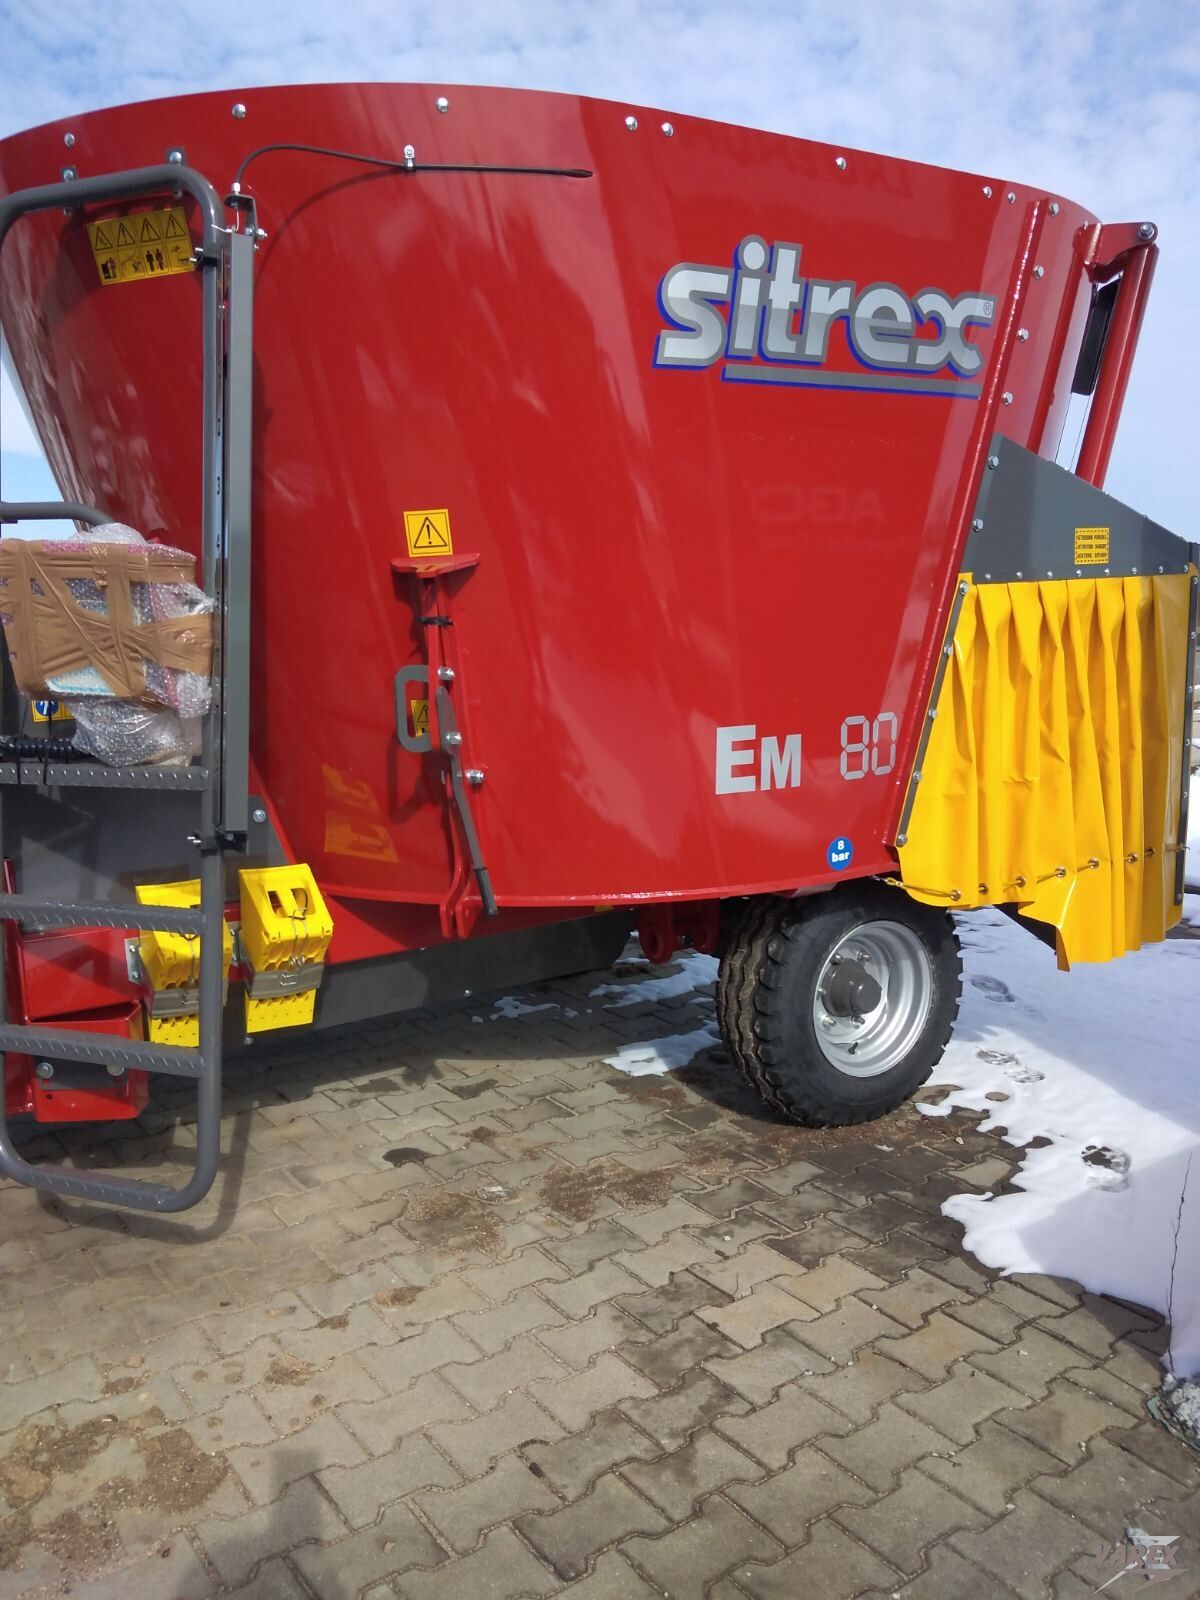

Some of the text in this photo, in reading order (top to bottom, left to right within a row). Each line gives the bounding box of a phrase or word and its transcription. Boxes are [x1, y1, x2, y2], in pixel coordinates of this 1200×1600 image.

[653, 234, 996, 379] sitrex
[715, 711, 898, 795] EM 80
[831, 851, 850, 863] bar
[837, 840, 845, 850] 8
